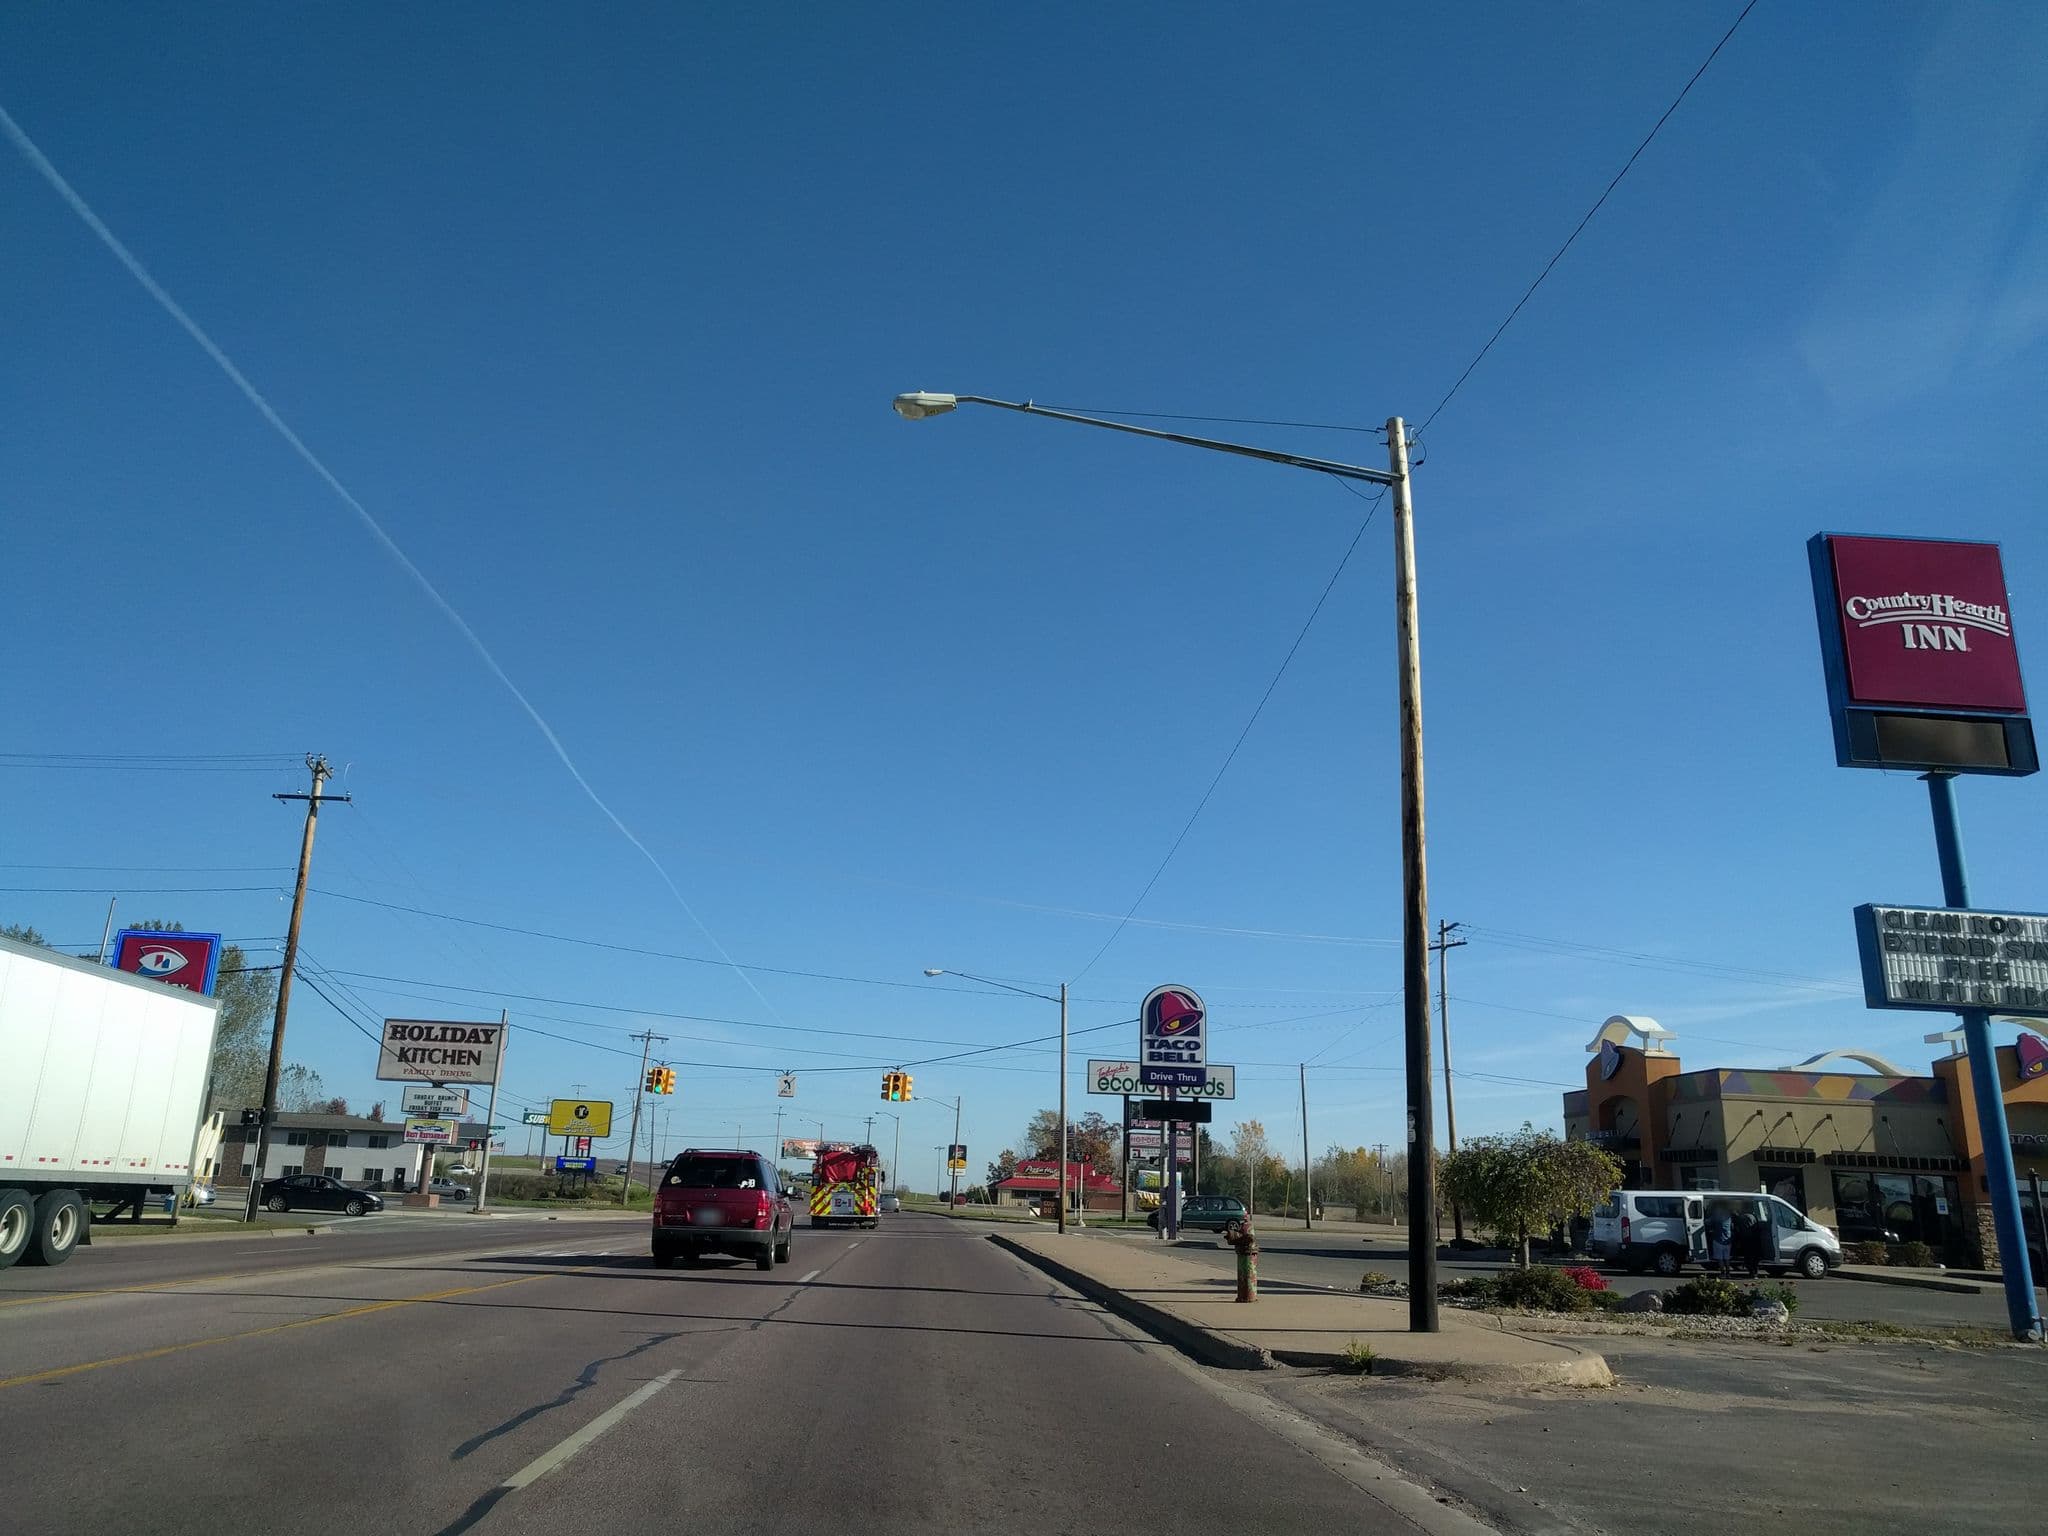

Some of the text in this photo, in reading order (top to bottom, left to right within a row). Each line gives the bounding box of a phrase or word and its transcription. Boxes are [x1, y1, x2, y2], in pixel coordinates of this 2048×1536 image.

[1845, 591, 2006, 625] Country Hearth
[1901, 623, 1966, 652] INN
[1885, 910, 1962, 933] CLEAN
[1884, 932, 1996, 958] EXTENDED
[1946, 959, 2010, 982] FREE
[388, 1024, 498, 1045] HOLIDAY
[1144, 1039, 1202, 1051] TACO
[397, 1046, 482, 1066] KITCHEN
[1148, 1051, 1202, 1063] BELL
[402, 1067, 473, 1078] FAMILY DINING
[1150, 1071, 1198, 1082] Drive Thru
